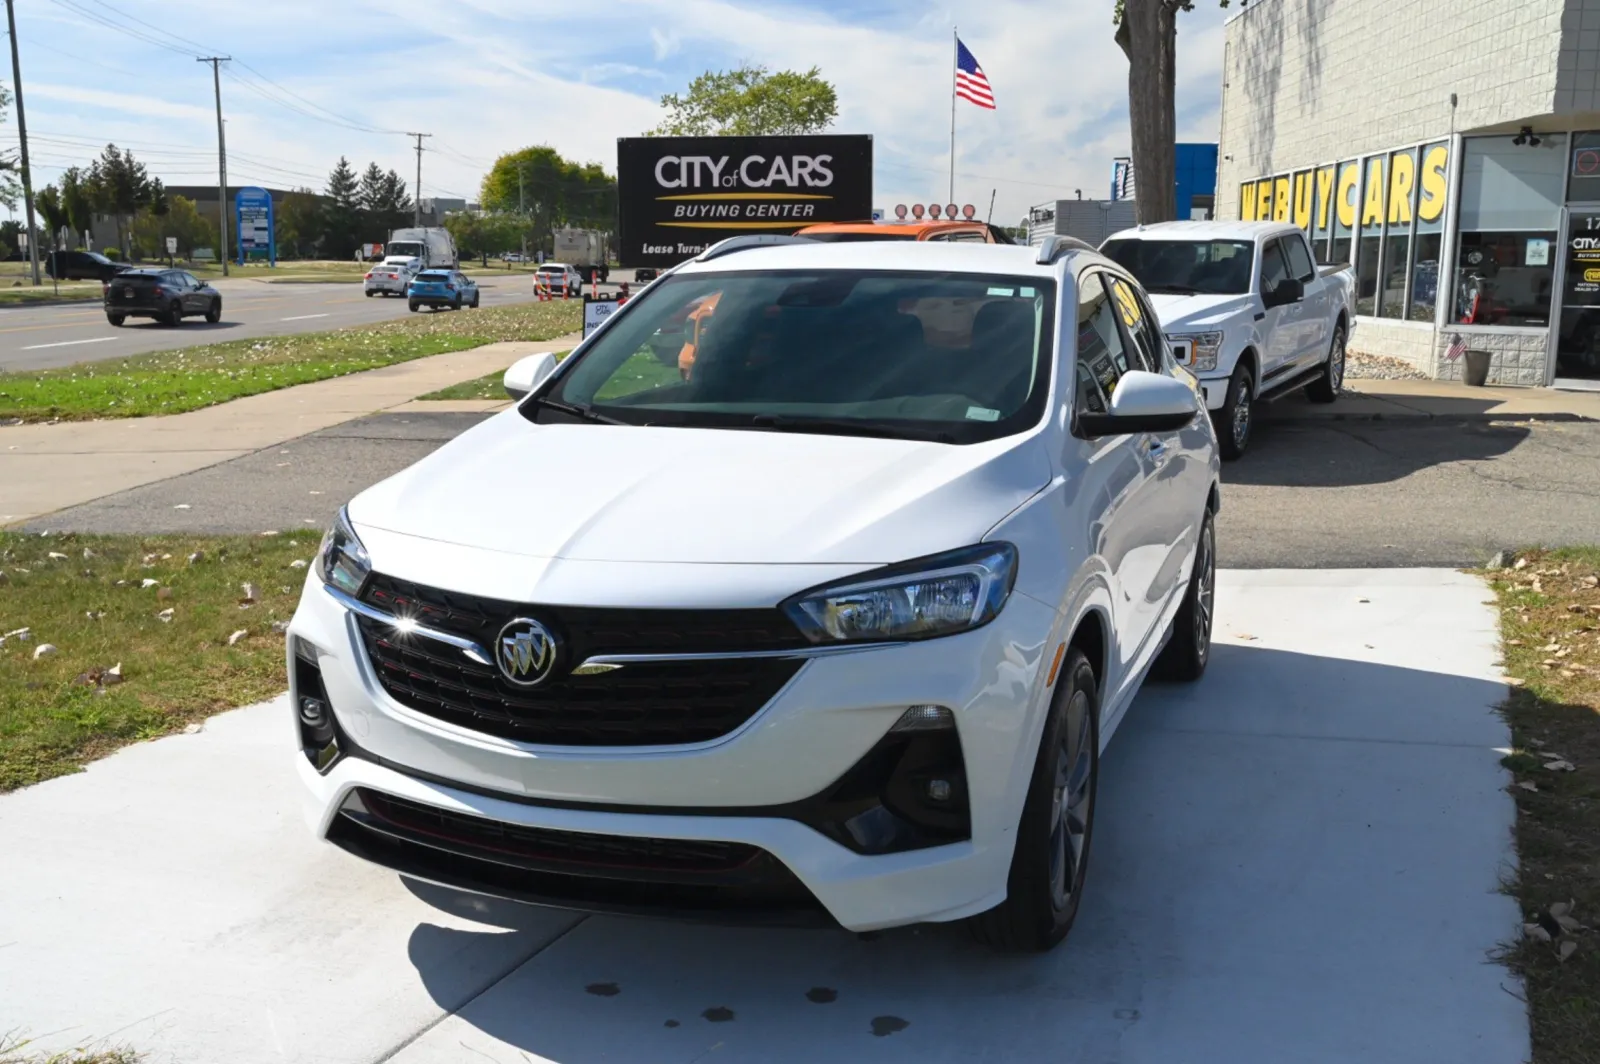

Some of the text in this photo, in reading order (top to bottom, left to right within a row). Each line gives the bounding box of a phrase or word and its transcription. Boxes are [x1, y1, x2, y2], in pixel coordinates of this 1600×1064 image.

[654, 154, 834, 188] CITY of CARS
[673, 204, 815, 217] BUYING CENTER
[642, 243, 674, 254] Lease
[1573, 237, 1599, 249] CITY
